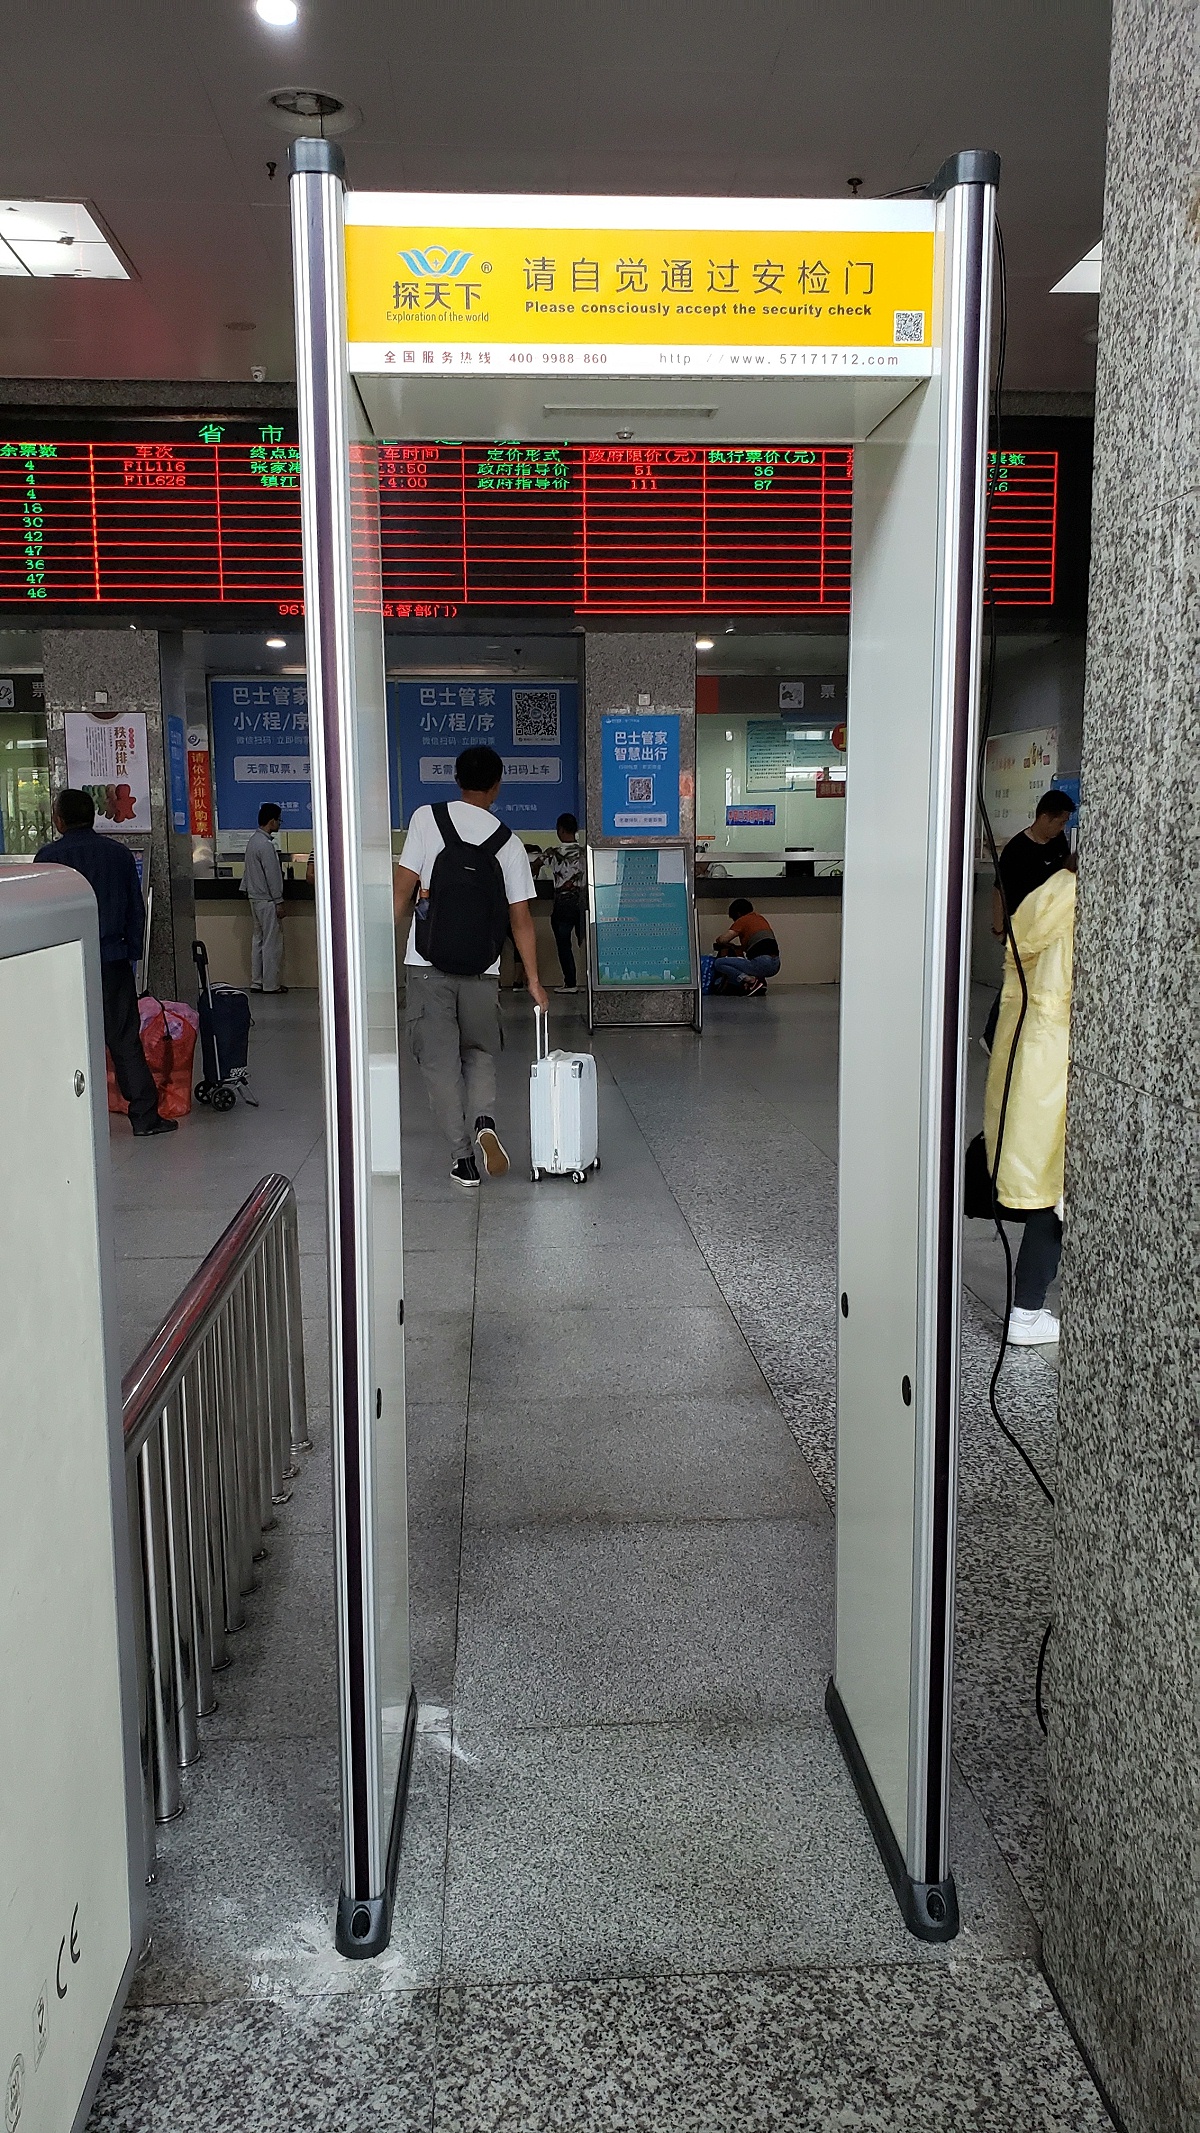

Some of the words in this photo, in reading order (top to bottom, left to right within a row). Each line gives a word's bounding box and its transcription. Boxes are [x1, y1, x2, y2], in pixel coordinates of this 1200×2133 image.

[522, 256, 875, 296] 请自觉通过安检门
[392, 280, 482, 310] 探天下
[525, 301, 575, 314] Please
[581, 301, 670, 316] consciously
[676, 303, 727, 317] accept
[733, 304, 756, 315] the
[762, 304, 822, 318] security
[828, 304, 872, 316] check
[386, 310, 437, 324] Exploration
[438, 311, 448, 322] of
[449, 311, 464, 322] the
[465, 311, 489, 323] world
[384, 350, 491, 365] 全国服务热线
[0, 444, 57, 457] 余票数
[135, 446, 173, 459] 车次
[379, 446, 439, 460] 车时间
[487, 449, 561, 462] 定价形式
[588, 450, 697, 463] 政府限价(元)
[708, 450, 817, 464] 执行票价(元)
[25, 460, 35, 471] 4
[477, 463, 570, 476] 政府指导价
[634, 466, 652, 476] 51
[754, 466, 774, 477] 36
[26, 474, 36, 485] 4
[260, 475, 299, 488] 镇江
[477, 477, 570, 490] 政府指导价
[631, 480, 658, 490] 111
[754, 480, 772, 491] 87
[26, 489, 37, 500] 4
[24, 503, 43, 514] 18
[23, 517, 44, 528] 30
[24, 531, 43, 542] 42
[25, 546, 43, 556] 47
[25, 560, 45, 570] 36
[26, 574, 45, 584] 47
[27, 588, 47, 598] 46
[232, 686, 308, 706] 巴士管家
[420, 687, 496, 707] 巴士管家
[419, 712, 495, 733] 小/程/序
[614, 730, 668, 746] 巴士管家
[114, 726, 129, 778] 秩序排队
[614, 747, 668, 761] 智慧出行
[190, 752, 209, 833] 请依次排队购票
